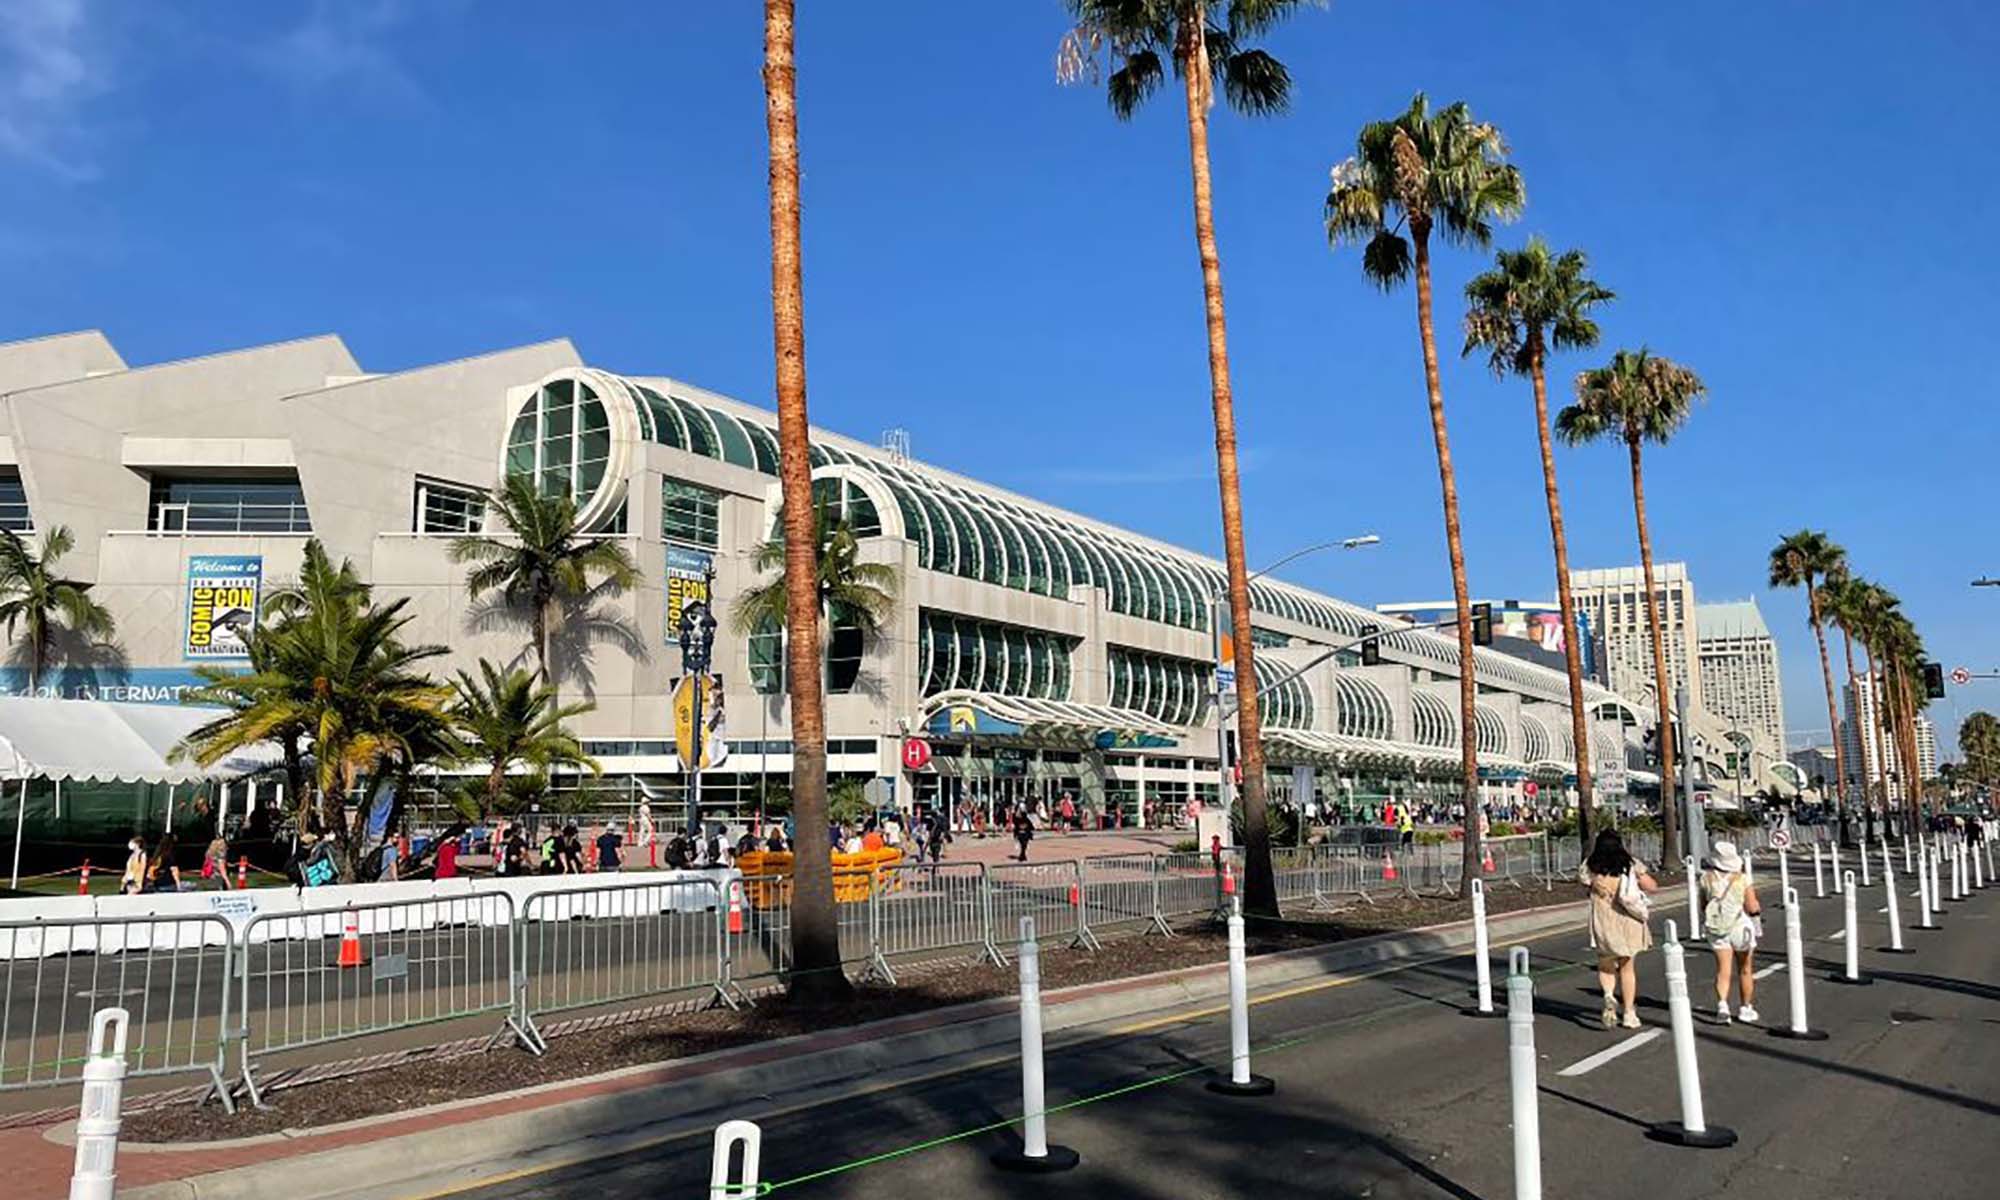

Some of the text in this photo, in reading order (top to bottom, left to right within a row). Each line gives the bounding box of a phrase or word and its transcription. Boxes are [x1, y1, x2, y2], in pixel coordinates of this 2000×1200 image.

[192, 560, 259, 572] Welcome to
[214, 588, 254, 610] CON
[683, 580, 707, 604] CON
[191, 588, 213, 645] COMIC
[908, 744, 920, 762] H
